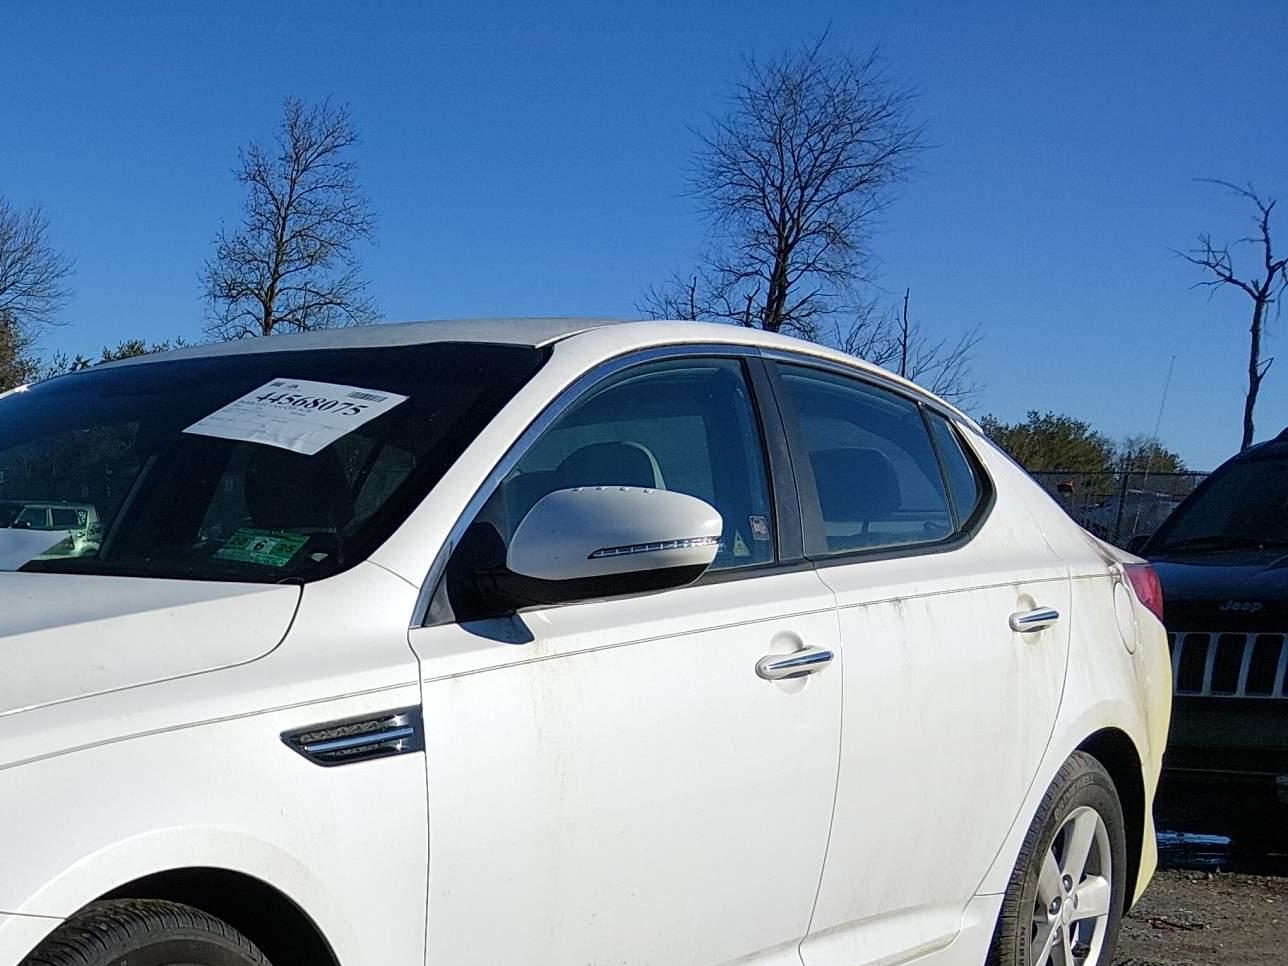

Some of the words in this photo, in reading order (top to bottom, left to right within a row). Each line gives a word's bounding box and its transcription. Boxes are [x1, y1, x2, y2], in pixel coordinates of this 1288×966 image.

[256, 391, 368, 416] 44568075
[253, 539, 269, 550] 6
[1219, 599, 1263, 613] Jeep
